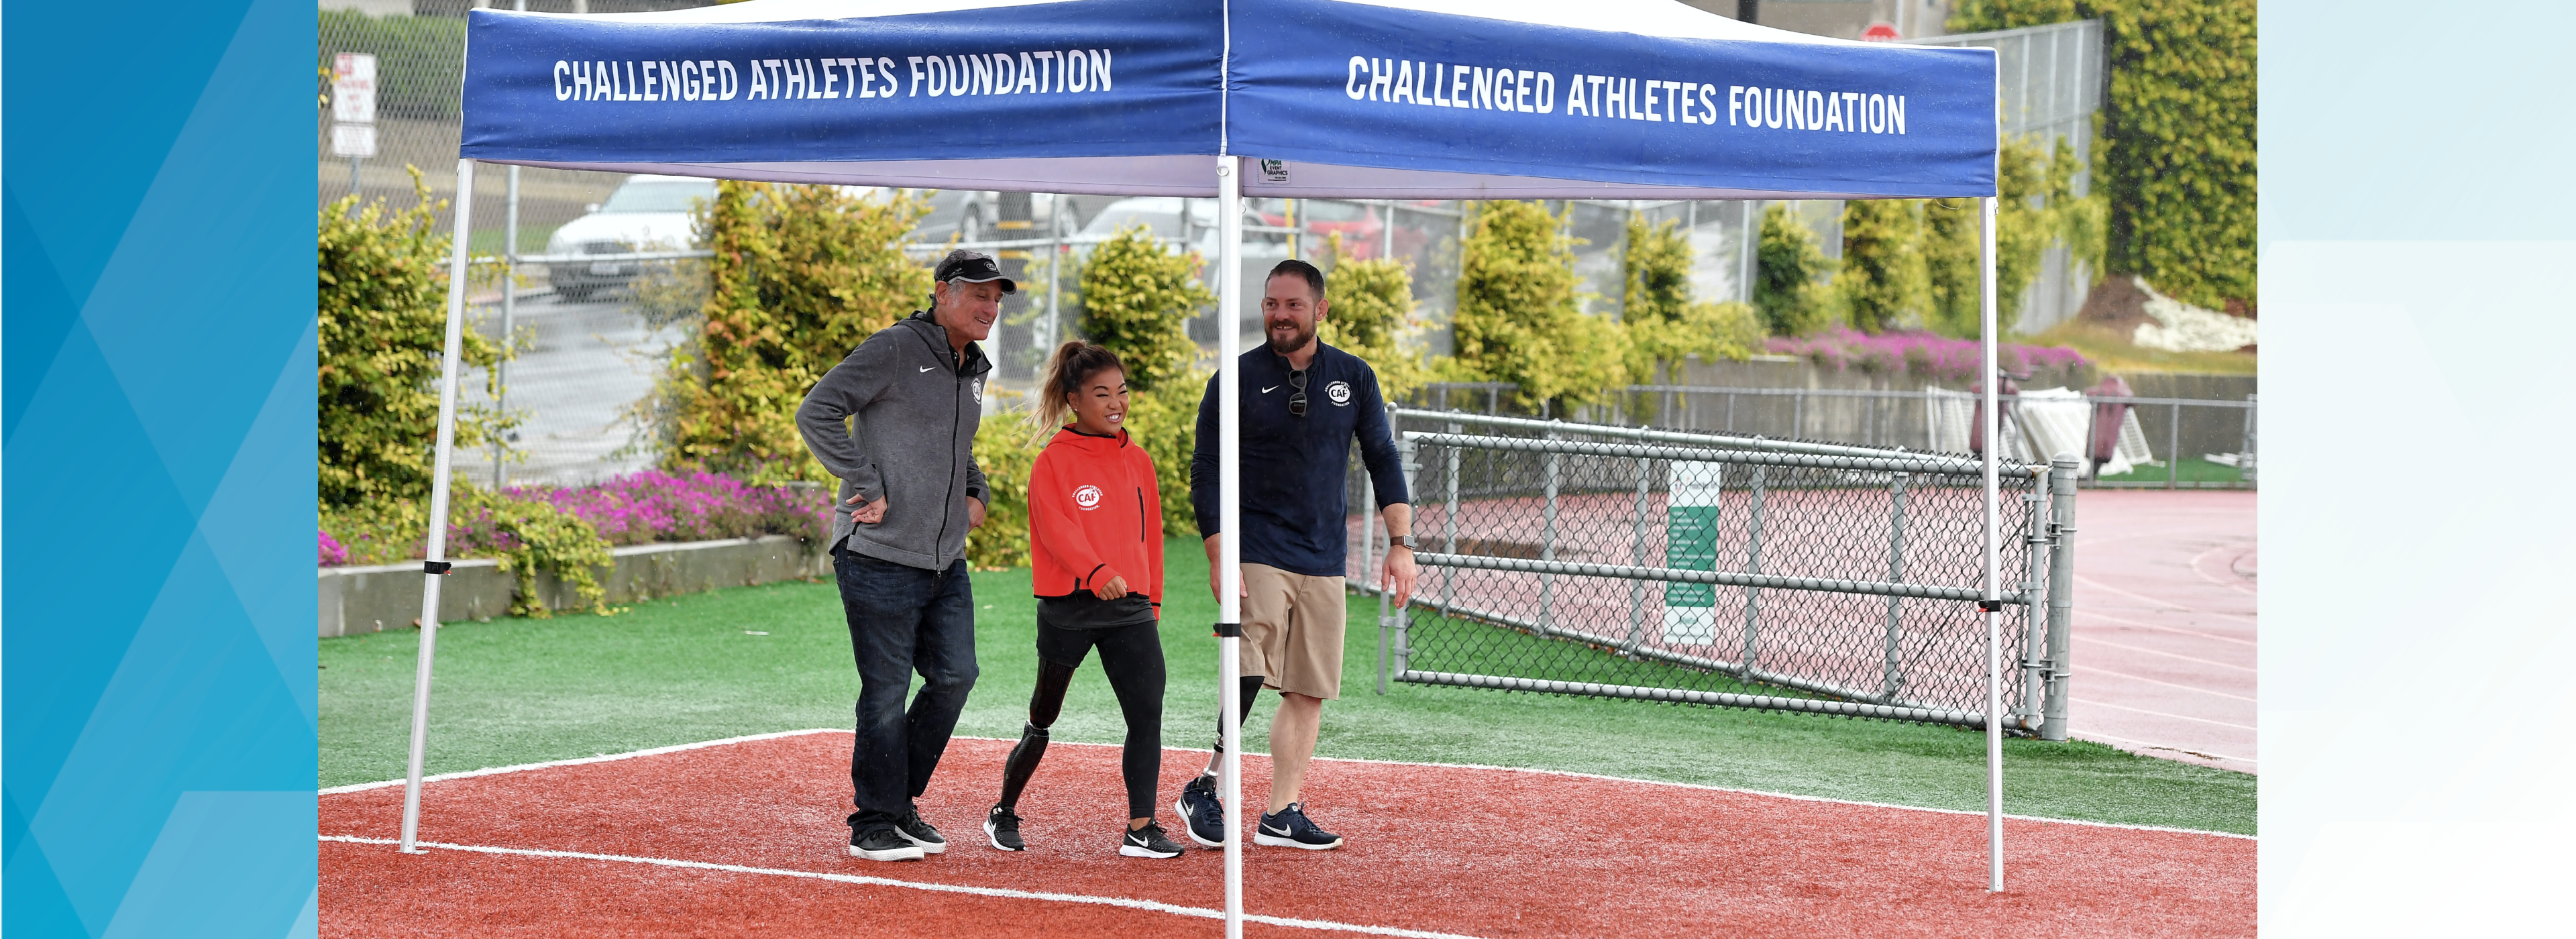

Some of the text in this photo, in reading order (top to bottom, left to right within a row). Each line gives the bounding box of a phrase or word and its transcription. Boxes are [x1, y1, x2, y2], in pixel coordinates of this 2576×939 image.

[553, 48, 1112, 101] CHALLENGED ATHLETES FOUNDATION
[1346, 56, 1906, 135] CHALLENGED ATHLETES FOUNDATION
[1330, 388, 1347, 398] CAF
[1078, 492, 1096, 502] CAF
